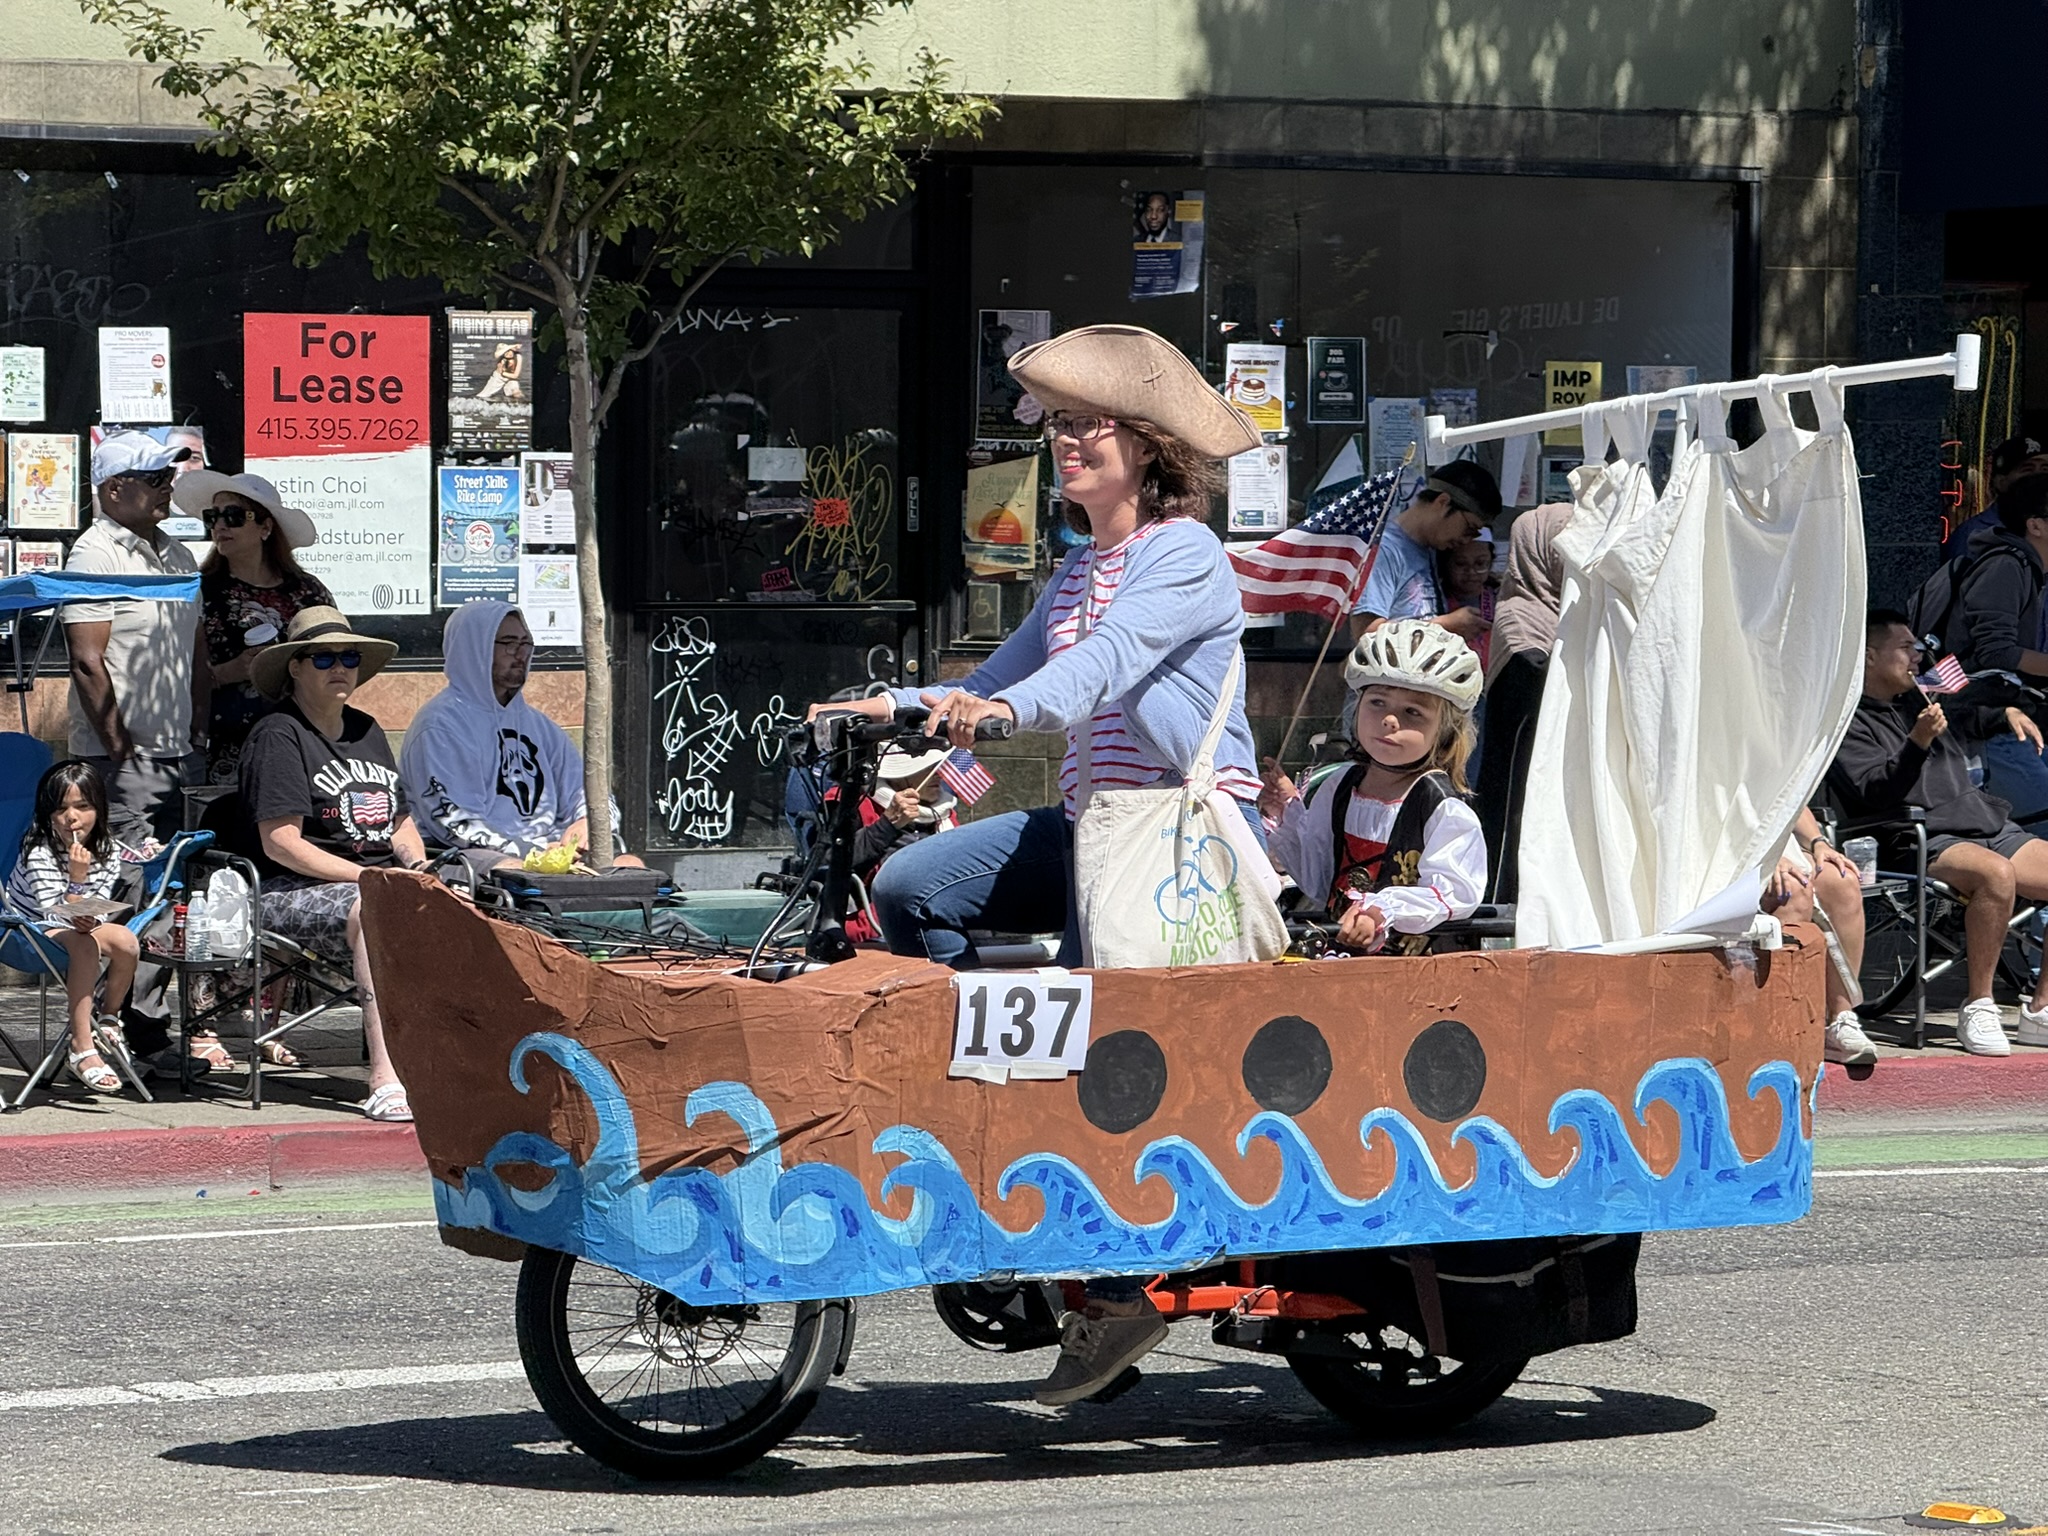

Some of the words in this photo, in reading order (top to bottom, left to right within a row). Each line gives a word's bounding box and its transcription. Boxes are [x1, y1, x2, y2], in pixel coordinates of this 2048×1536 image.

[452, 318, 493, 329] RISING
[496, 318, 529, 330] SEAS
[301, 322, 376, 359] For
[273, 366, 403, 404] Lease
[1553, 370, 1592, 388] IMP
[1553, 392, 1585, 405] ROV
[257, 417, 419, 440] 415.395.7262
[274, 476, 314, 494] stin
[322, 476, 367, 494] Choi
[454, 475, 483, 488] Street
[485, 476, 508, 488] Skills
[281, 498, 385, 511] n.choi@am.jll.com
[457, 490, 476, 503] Bike
[478, 490, 502, 505] Camp
[910, 481, 918, 518] PULL
[314, 528, 405, 545] adstubner
[292, 551, 412, 564] dstubner@am.jll.com
[395, 589, 424, 605] JLL
[313, 759, 353, 796] OLD
[346, 758, 399, 793] NAVY
[322, 807, 339, 819] 20
[1160, 826, 1183, 840] BIKE
[964, 986, 1082, 1057] 137
